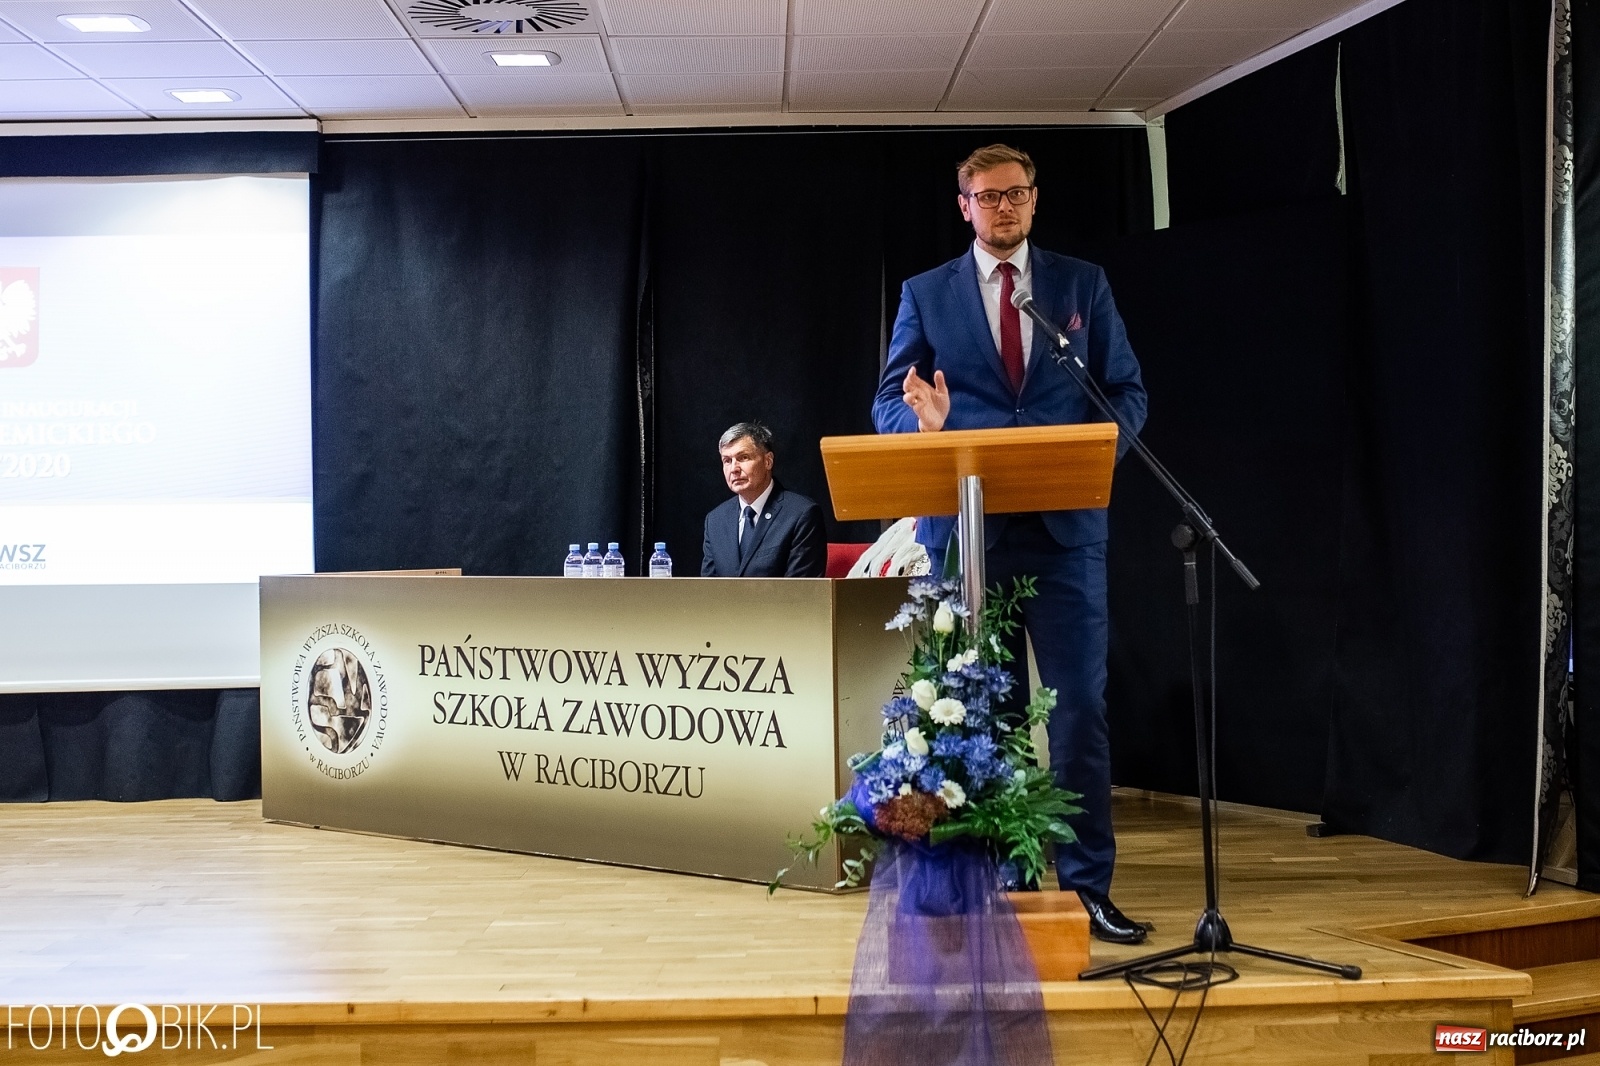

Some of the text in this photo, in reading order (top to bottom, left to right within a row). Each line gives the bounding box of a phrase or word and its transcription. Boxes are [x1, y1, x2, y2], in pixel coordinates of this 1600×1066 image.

[302, 623, 339, 652] WYŻSZA
[340, 624, 376, 662] SZKOŁA
[371, 661, 388, 750] ZAWODOWA
[418, 634, 795, 695] PAŃSTWOWA WYŻSZA
[432, 691, 787, 749] SZKOŁA ZAWODOWA
[316, 756, 370, 780] RACIBORZU
[497, 750, 706, 799] W RACIBORZU
